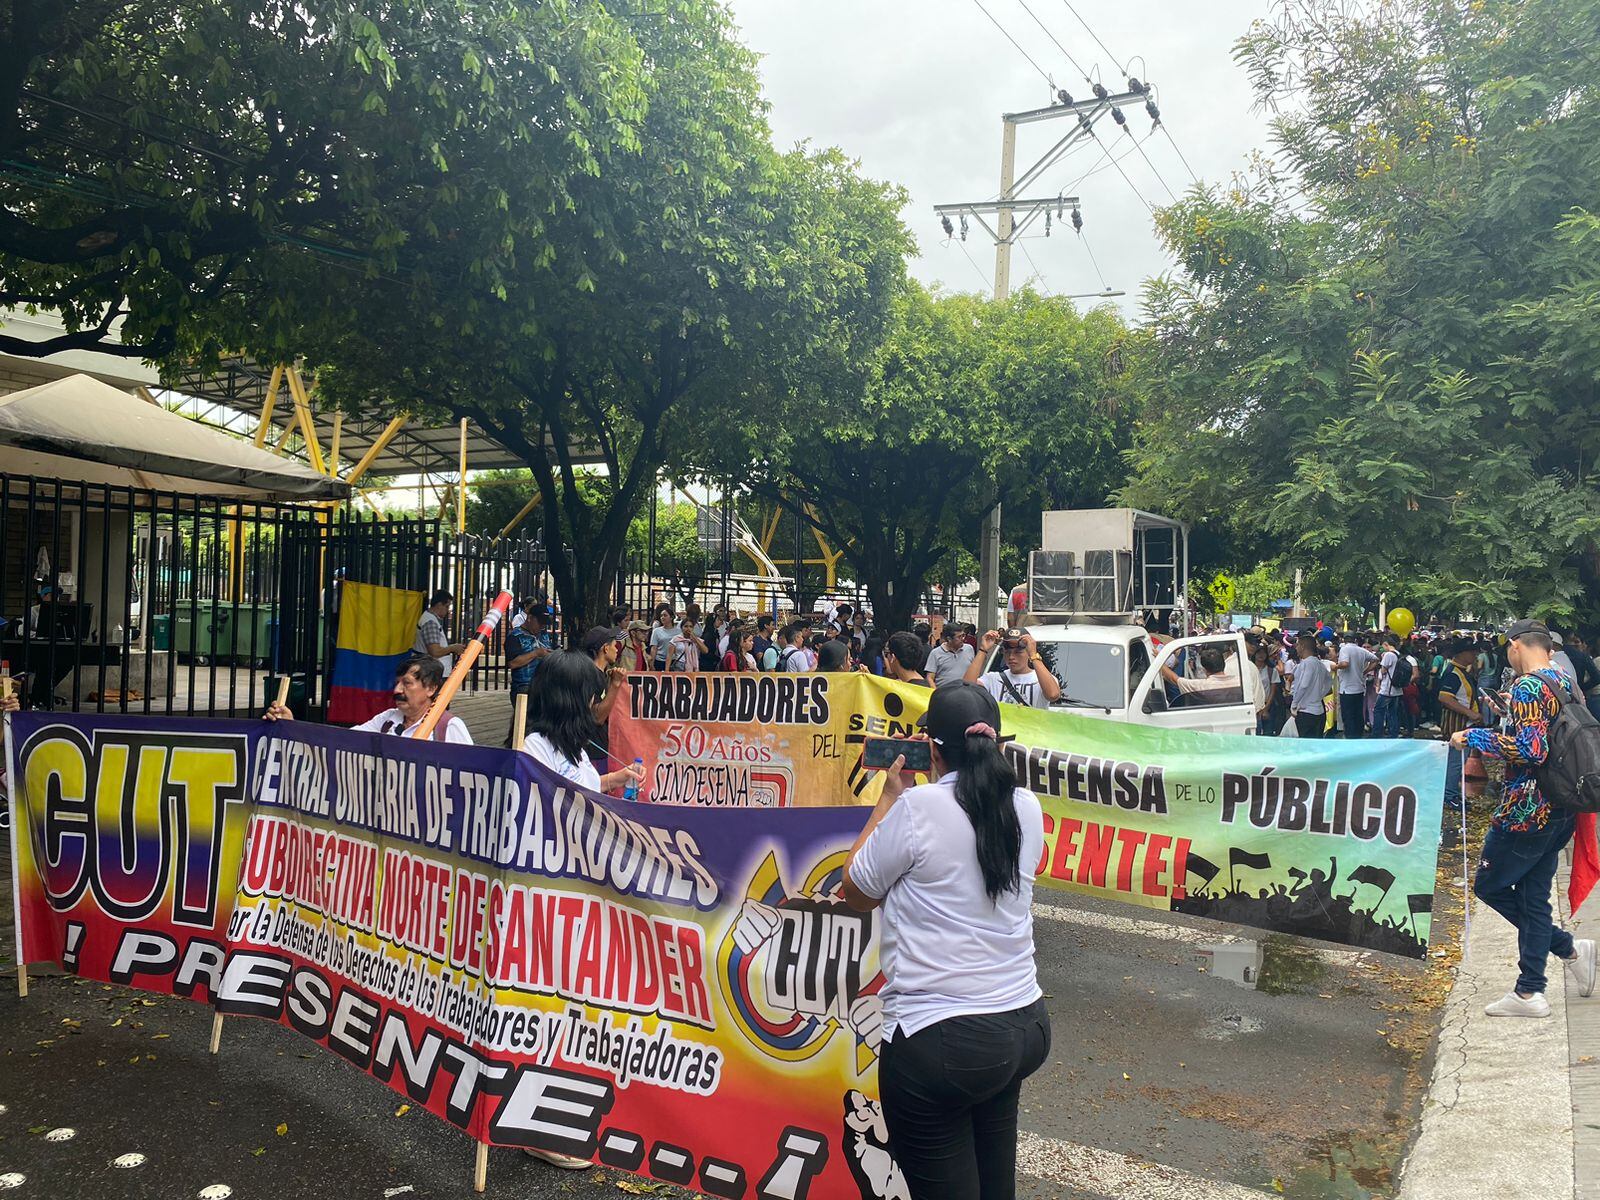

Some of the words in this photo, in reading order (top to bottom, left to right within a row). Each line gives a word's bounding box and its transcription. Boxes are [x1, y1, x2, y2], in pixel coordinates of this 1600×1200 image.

[628, 675, 829, 724] TRABAJADORES
[664, 725, 706, 759] 50
[709, 738, 771, 762] Años
[812, 733, 840, 758] DEL
[20, 726, 247, 928] CUT
[252, 736, 330, 815] CENTRAL
[335, 749, 420, 839] UNITARIA
[425, 765, 454, 848] DE
[460, 771, 719, 906] TRABAJADORES
[650, 761, 750, 806] SINDESENA
[1004, 742, 1168, 814] DEFENSA
[1175, 783, 1192, 801] DE
[1198, 786, 1216, 804] LO
[1220, 767, 1417, 846] PÚBLICO
[380, 853, 451, 955] NORTE
[454, 873, 487, 969] DE
[486, 883, 711, 1024] SANTANDER
[766, 908, 861, 1020] CUT
[251, 902, 272, 940] la
[273, 906, 315, 956] Defensa
[315, 922, 329, 962] de
[329, 927, 344, 970] los
[346, 935, 398, 995] Derechos
[398, 958, 415, 1002] de
[416, 963, 437, 1013] los
[438, 973, 540, 1049] Trabajadores
[541, 1017, 562, 1065] y
[565, 1008, 719, 1090] Trabajadoras
